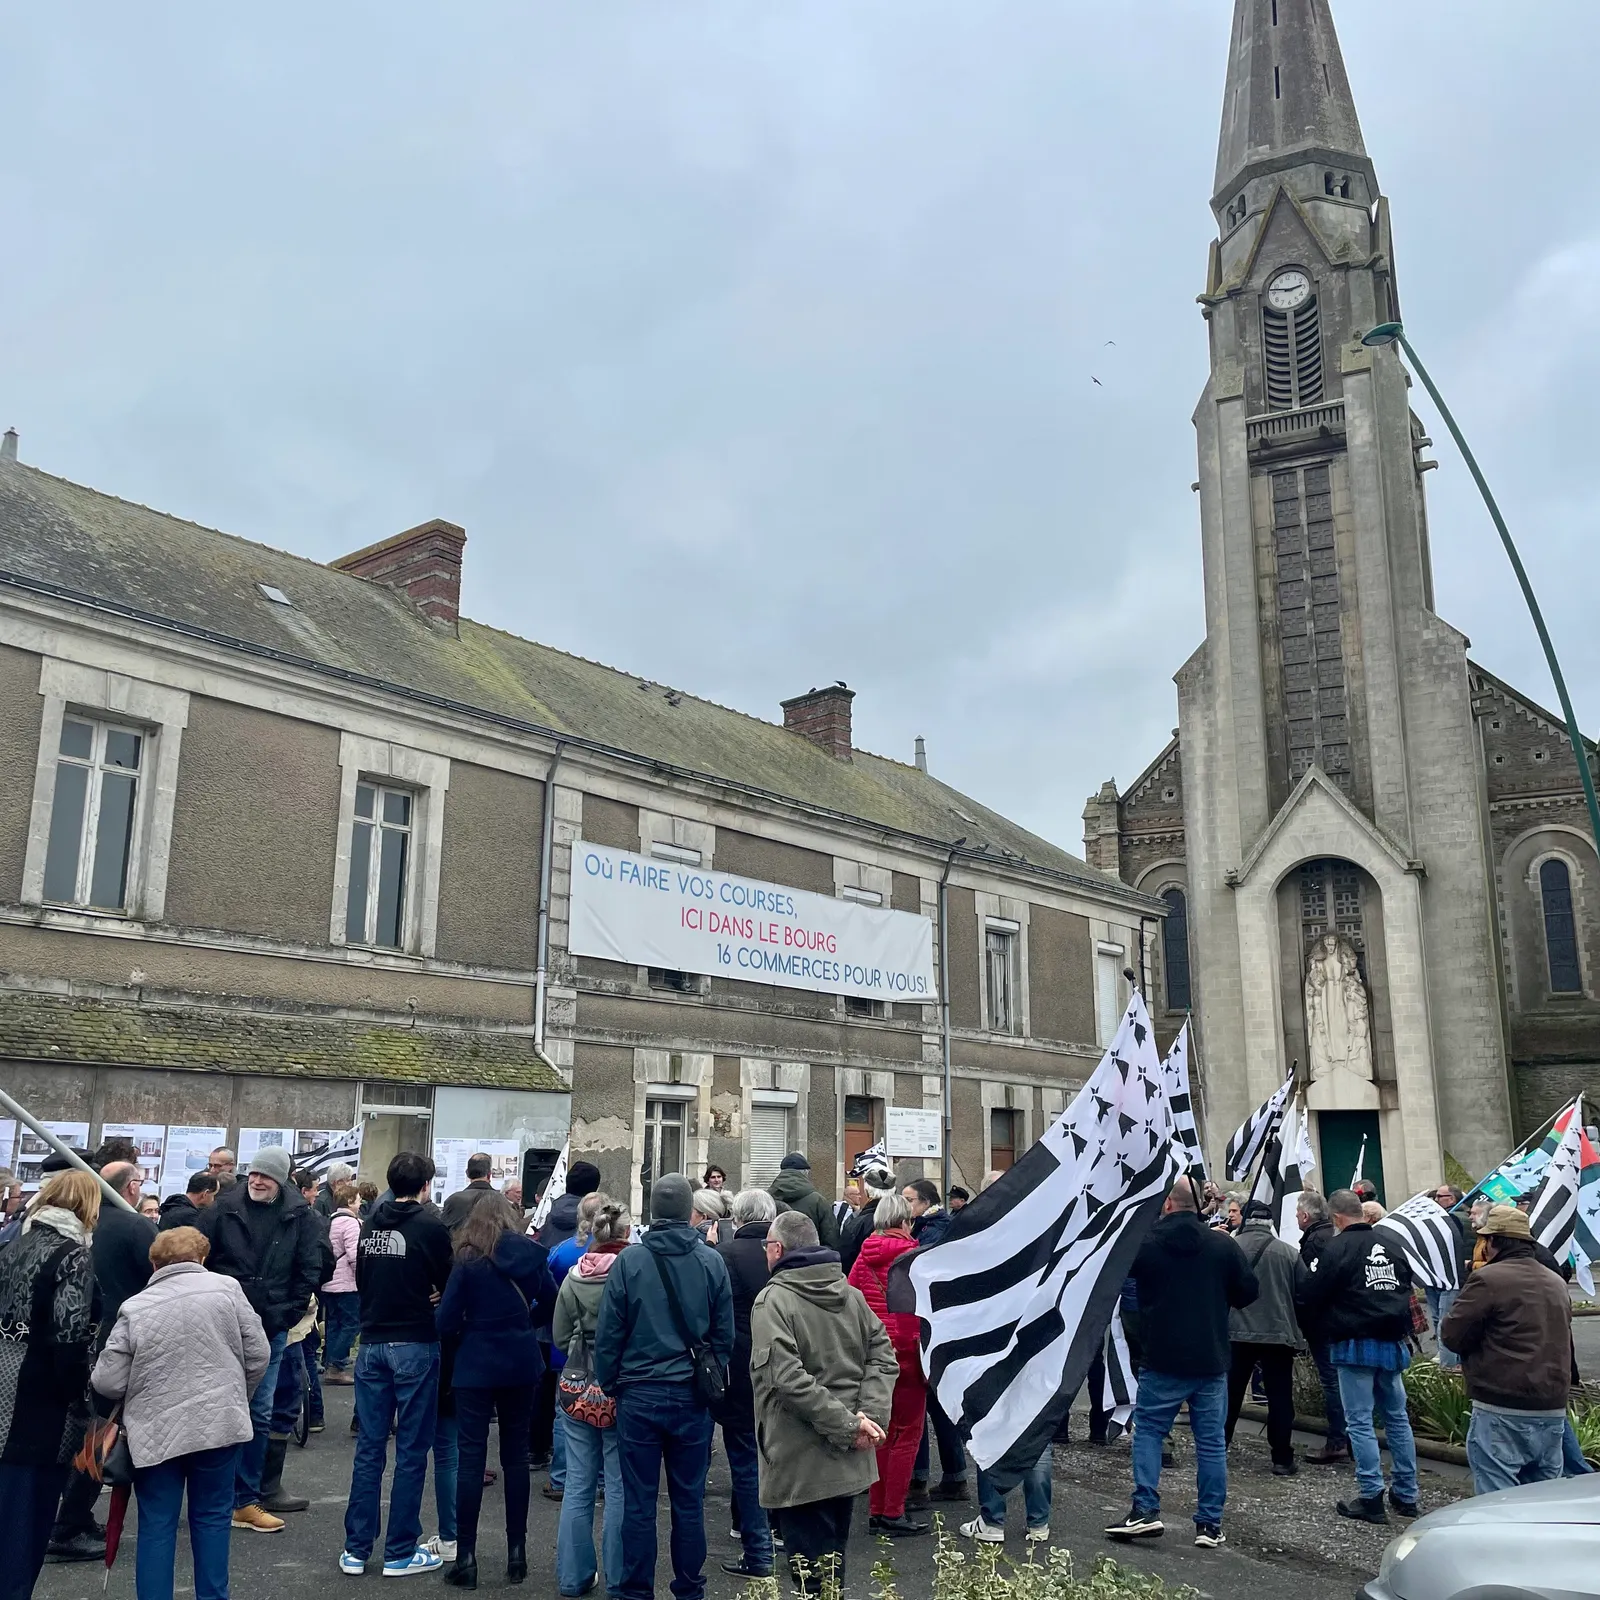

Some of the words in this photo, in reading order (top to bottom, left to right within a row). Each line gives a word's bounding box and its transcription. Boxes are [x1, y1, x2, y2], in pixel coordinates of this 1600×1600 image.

[585, 854, 613, 880] Où
[620, 860, 671, 892] FAIRE
[677, 872, 714, 900] VOS
[720, 883, 798, 919] COURSES,
[681, 906, 703, 931] ICI
[709, 911, 753, 940] DANS
[759, 921, 779, 944] LE
[784, 926, 837, 954] BOURG
[717, 943, 731, 965] 16
[737, 947, 840, 982] COMMERCES
[844, 964, 882, 989] POUR
[886, 971, 928, 994] VOUS!
[360, 1238, 388, 1247] NORTH
[372, 1230, 390, 1238] THE
[364, 1246, 388, 1254] FACE
